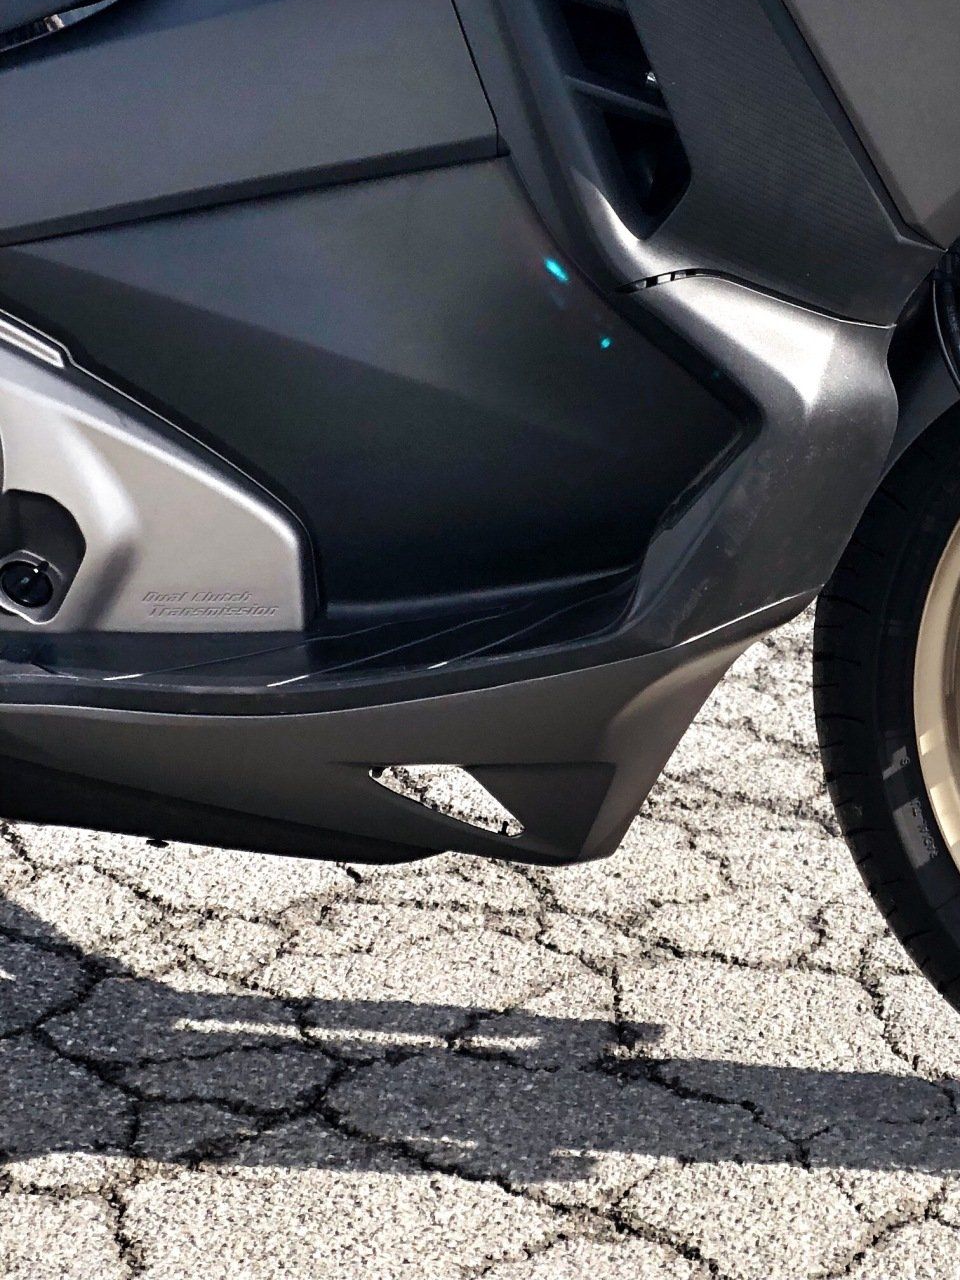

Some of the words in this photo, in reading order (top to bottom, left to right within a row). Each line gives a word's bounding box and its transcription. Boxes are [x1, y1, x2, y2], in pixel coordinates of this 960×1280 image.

[142, 591, 188, 602] Dual
[191, 591, 252, 602] Clutch
[148, 604, 279, 618] Transmission
